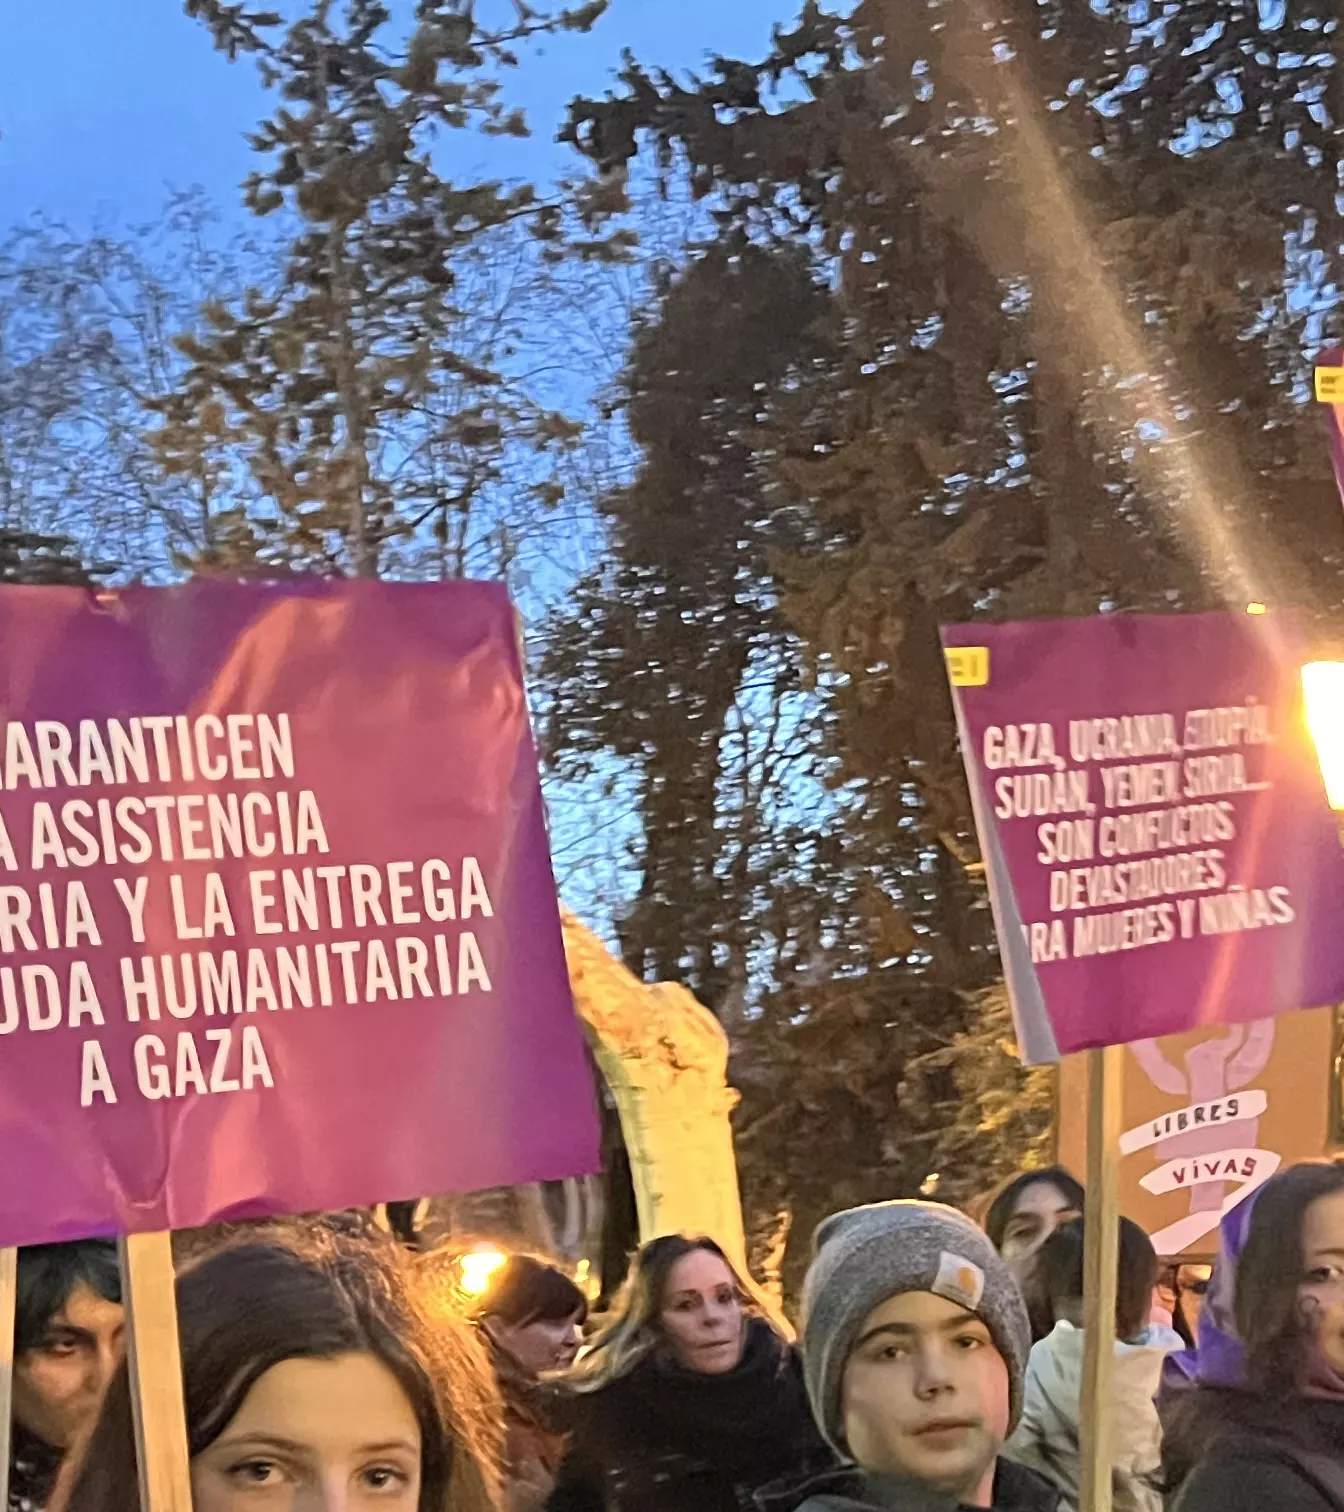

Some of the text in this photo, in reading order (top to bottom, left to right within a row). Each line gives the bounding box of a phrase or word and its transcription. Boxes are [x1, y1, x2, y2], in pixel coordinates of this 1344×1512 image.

[983, 722, 1067, 771] GAZA,
[30, 790, 330, 871] ASISTENCIA
[1037, 818, 1095, 865] SON
[113, 877, 149, 944] Y
[171, 872, 235, 941] LA
[256, 856, 494, 936] ENTREGA
[1049, 848, 1226, 912] DEVASTADORES
[1177, 898, 1197, 939] Y
[123, 931, 493, 1024] HUMANITARIA
[80, 1026, 275, 1107] A GAZA
[1152, 1098, 1239, 1138] LIBRES
